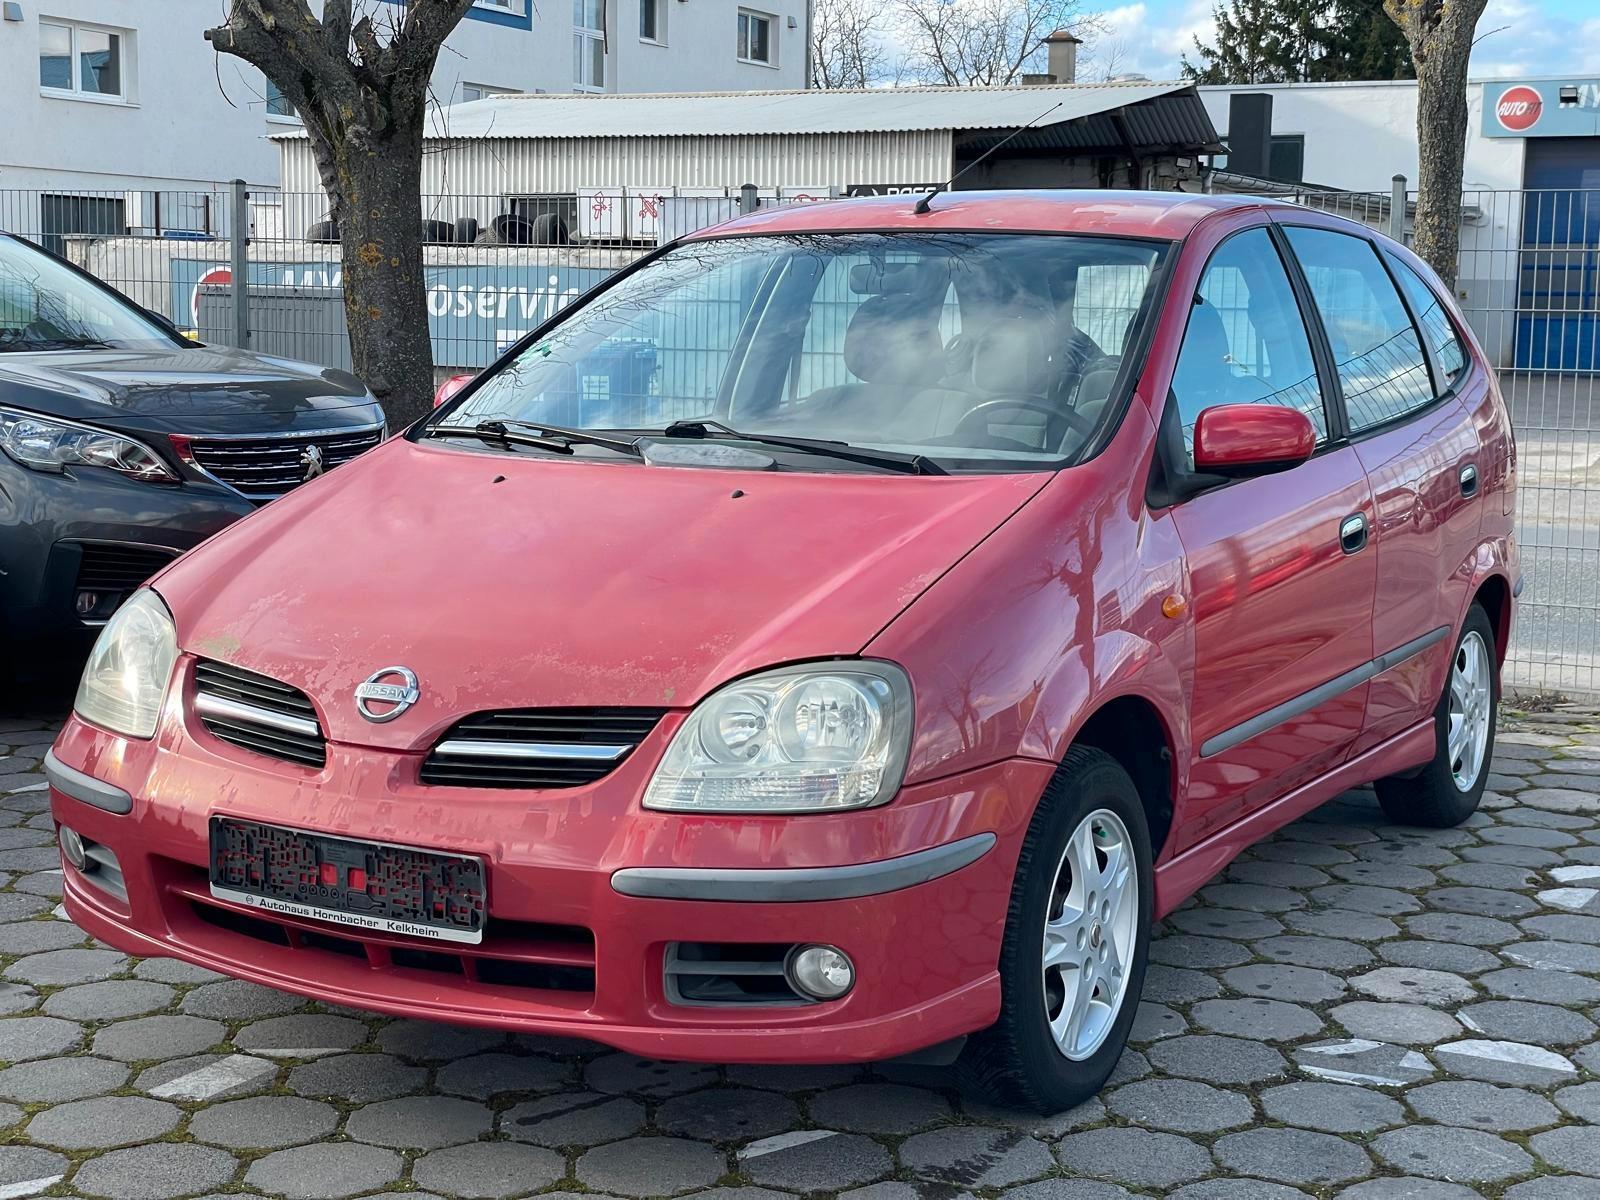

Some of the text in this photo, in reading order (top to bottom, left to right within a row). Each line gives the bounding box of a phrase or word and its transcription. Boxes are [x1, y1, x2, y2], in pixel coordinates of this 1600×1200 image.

[360, 685, 410, 699] NISSAN
[259, 898, 440, 938] Autohaus Hornbacher Kelkheim
